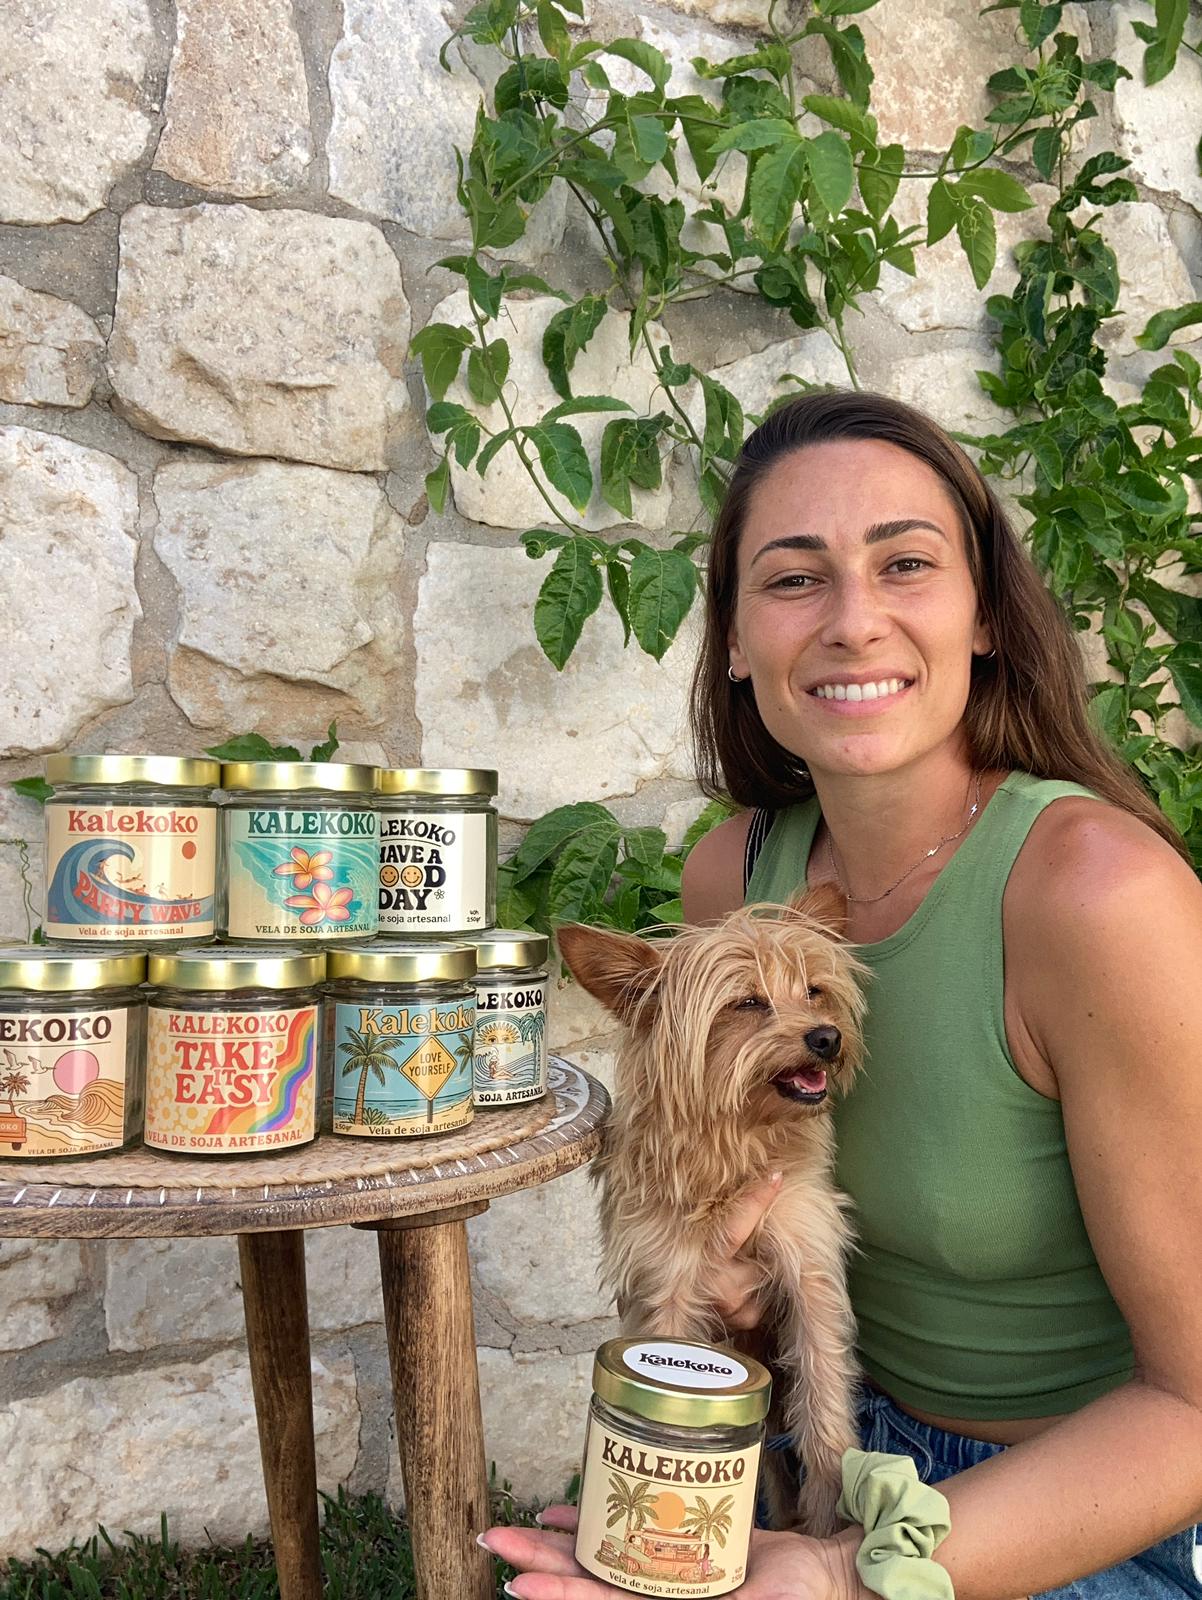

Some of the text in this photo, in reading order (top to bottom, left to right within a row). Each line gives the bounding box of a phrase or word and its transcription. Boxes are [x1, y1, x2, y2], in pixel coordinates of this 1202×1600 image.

[68, 810, 198, 833] Kalekoko
[248, 811, 376, 835] KALEKOKO
[380, 819, 456, 846] LEKOKO
[427, 848, 443, 865] A
[74, 870, 145, 924] PARTY
[151, 902, 201, 923] WAVE
[379, 888, 432, 910] DAY
[255, 923, 370, 934] VELA DE SOJA ARTESANAL
[387, 914, 404, 925] soja
[406, 914, 451, 923] artesanal
[79, 926, 184, 938] Vela de soja artesanal
[476, 989, 542, 1010] LEKOKO
[0, 1016, 112, 1042] EKOKO
[168, 1014, 289, 1034] KALEKOKO
[359, 1004, 475, 1035] Kalekoko
[175, 1041, 273, 1070] TAKE
[420, 1052, 442, 1064] LOVE
[214, 1069, 236, 1086] IT
[409, 1063, 451, 1077] YOURSELF
[175, 1072, 277, 1105] EASY
[478, 1085, 544, 1103] SOJA ARTESANAL
[368, 1117, 468, 1136] Vela de soja artesanal
[79, 1141, 114, 1152] ARTESANAL
[146, 1130, 302, 1148] VELA DE SOJA ARTESANAL
[639, 1352, 733, 1375] Kalekoko
[602, 1436, 745, 1483] KALEKOKO
[608, 1571, 710, 1595] Vela de soja artesanal
